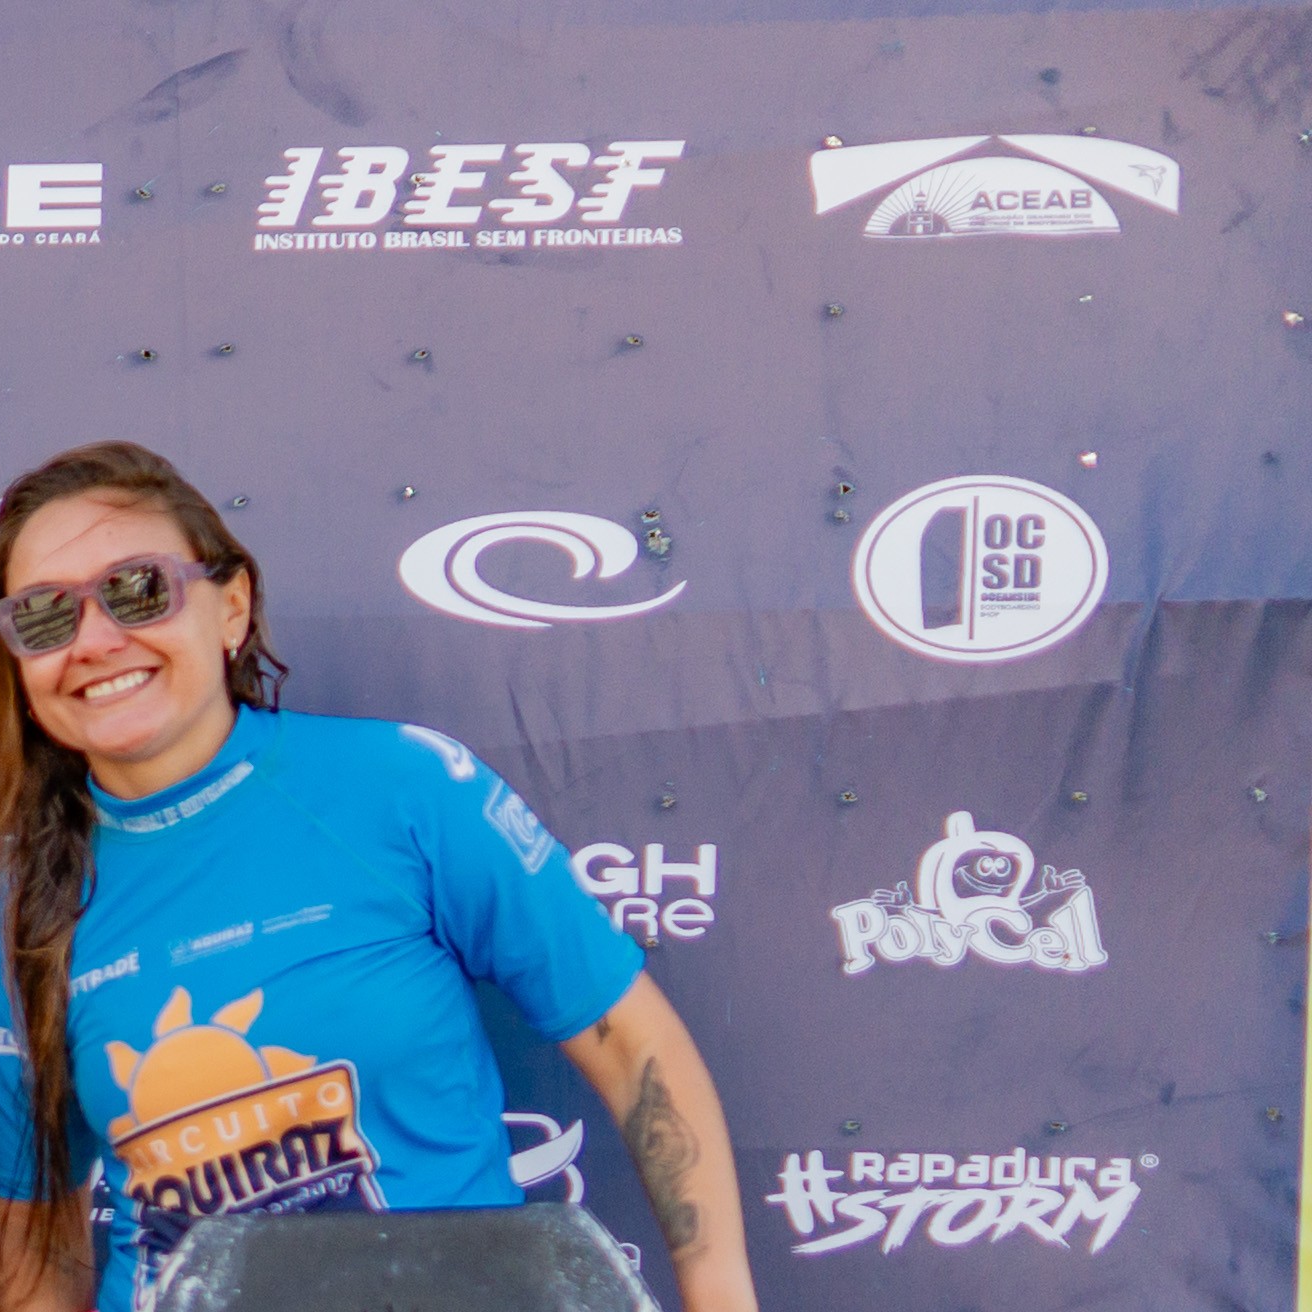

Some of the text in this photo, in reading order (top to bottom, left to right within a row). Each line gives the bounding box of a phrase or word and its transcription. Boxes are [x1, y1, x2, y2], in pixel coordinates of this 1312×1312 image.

[257, 140, 686, 226] IBESF
[969, 189, 1093, 211] ACEAB
[34, 230, 103, 246] CEARÁ
[254, 227, 683, 251] INSTITUTO BRASIL SEM FRONTEIRAS
[983, 513, 1046, 550] OC
[981, 553, 1043, 590] SD
[789, 1181, 1142, 1255] STORM
